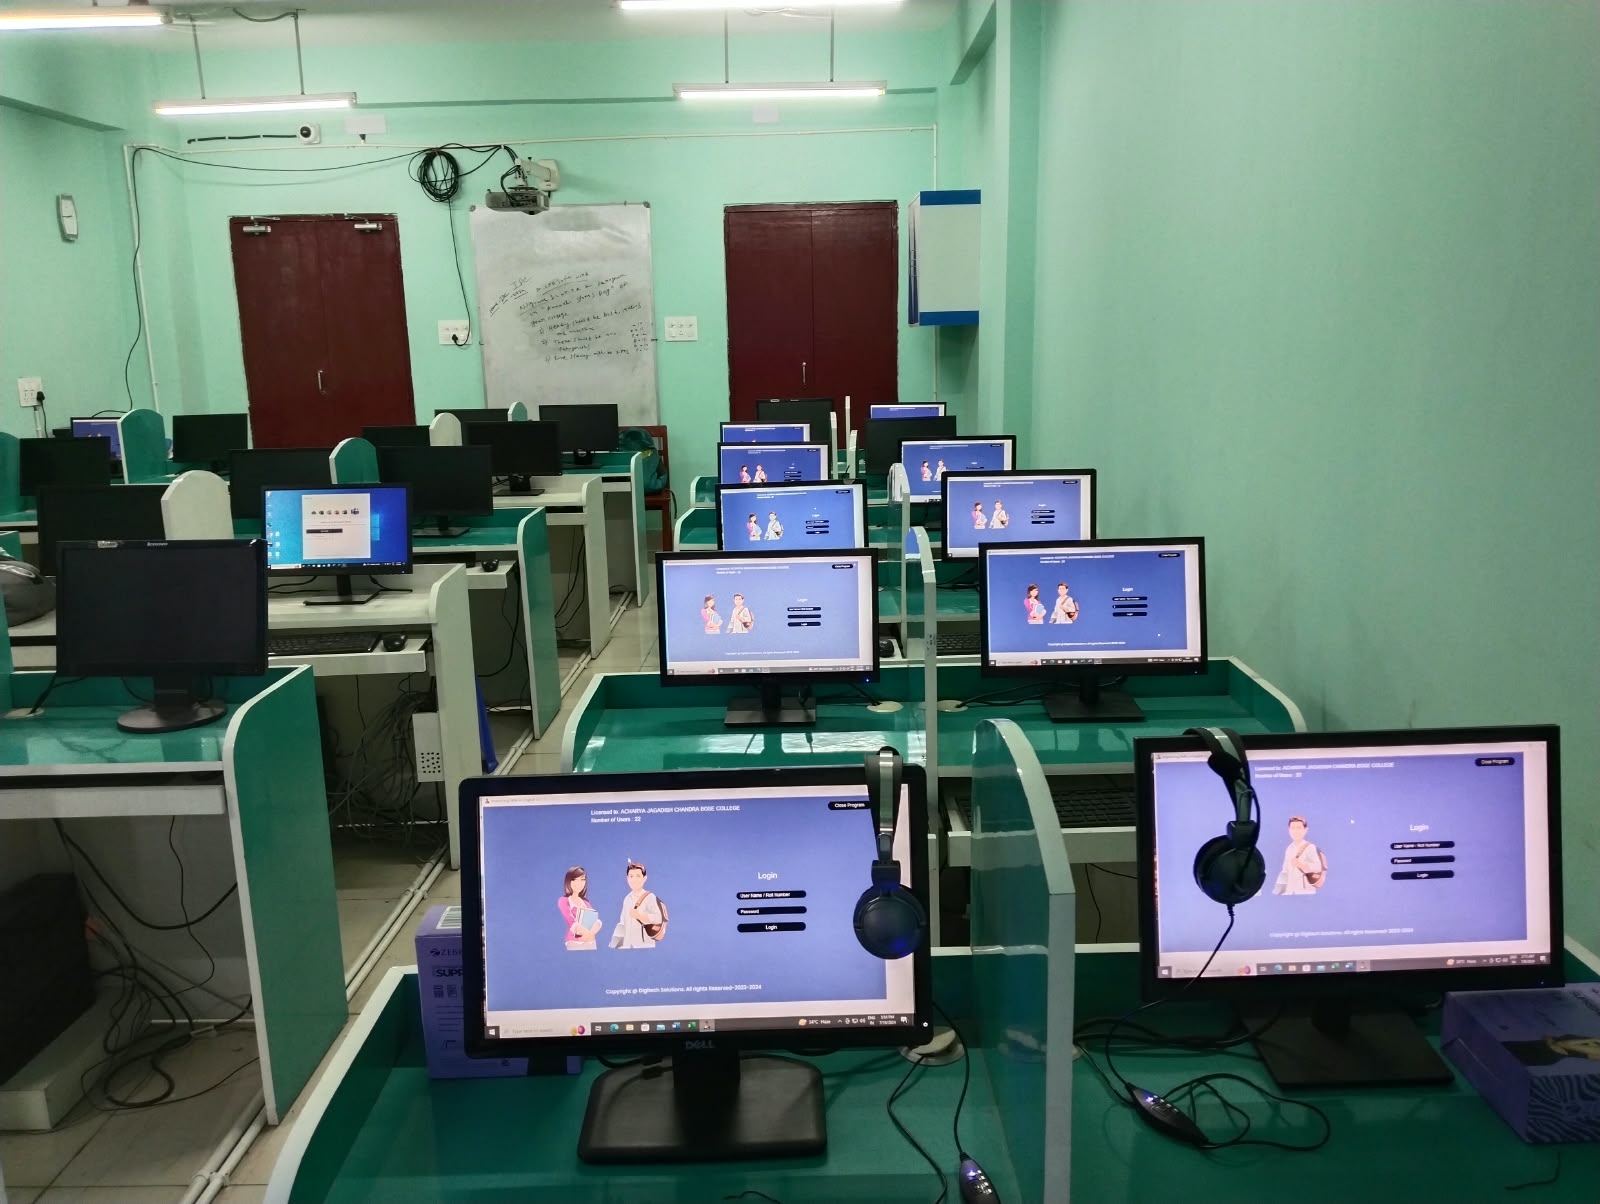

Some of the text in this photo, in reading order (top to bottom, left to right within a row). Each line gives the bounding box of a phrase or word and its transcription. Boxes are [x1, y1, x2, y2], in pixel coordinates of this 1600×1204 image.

[620, 807, 646, 815] ACHARYA
[647, 806, 673, 814] JAGADISH
[1410, 824, 1429, 832] Login
[757, 871, 778, 881] Login
[605, 988, 631, 996] Copyright
[685, 1040, 716, 1050] DELL
